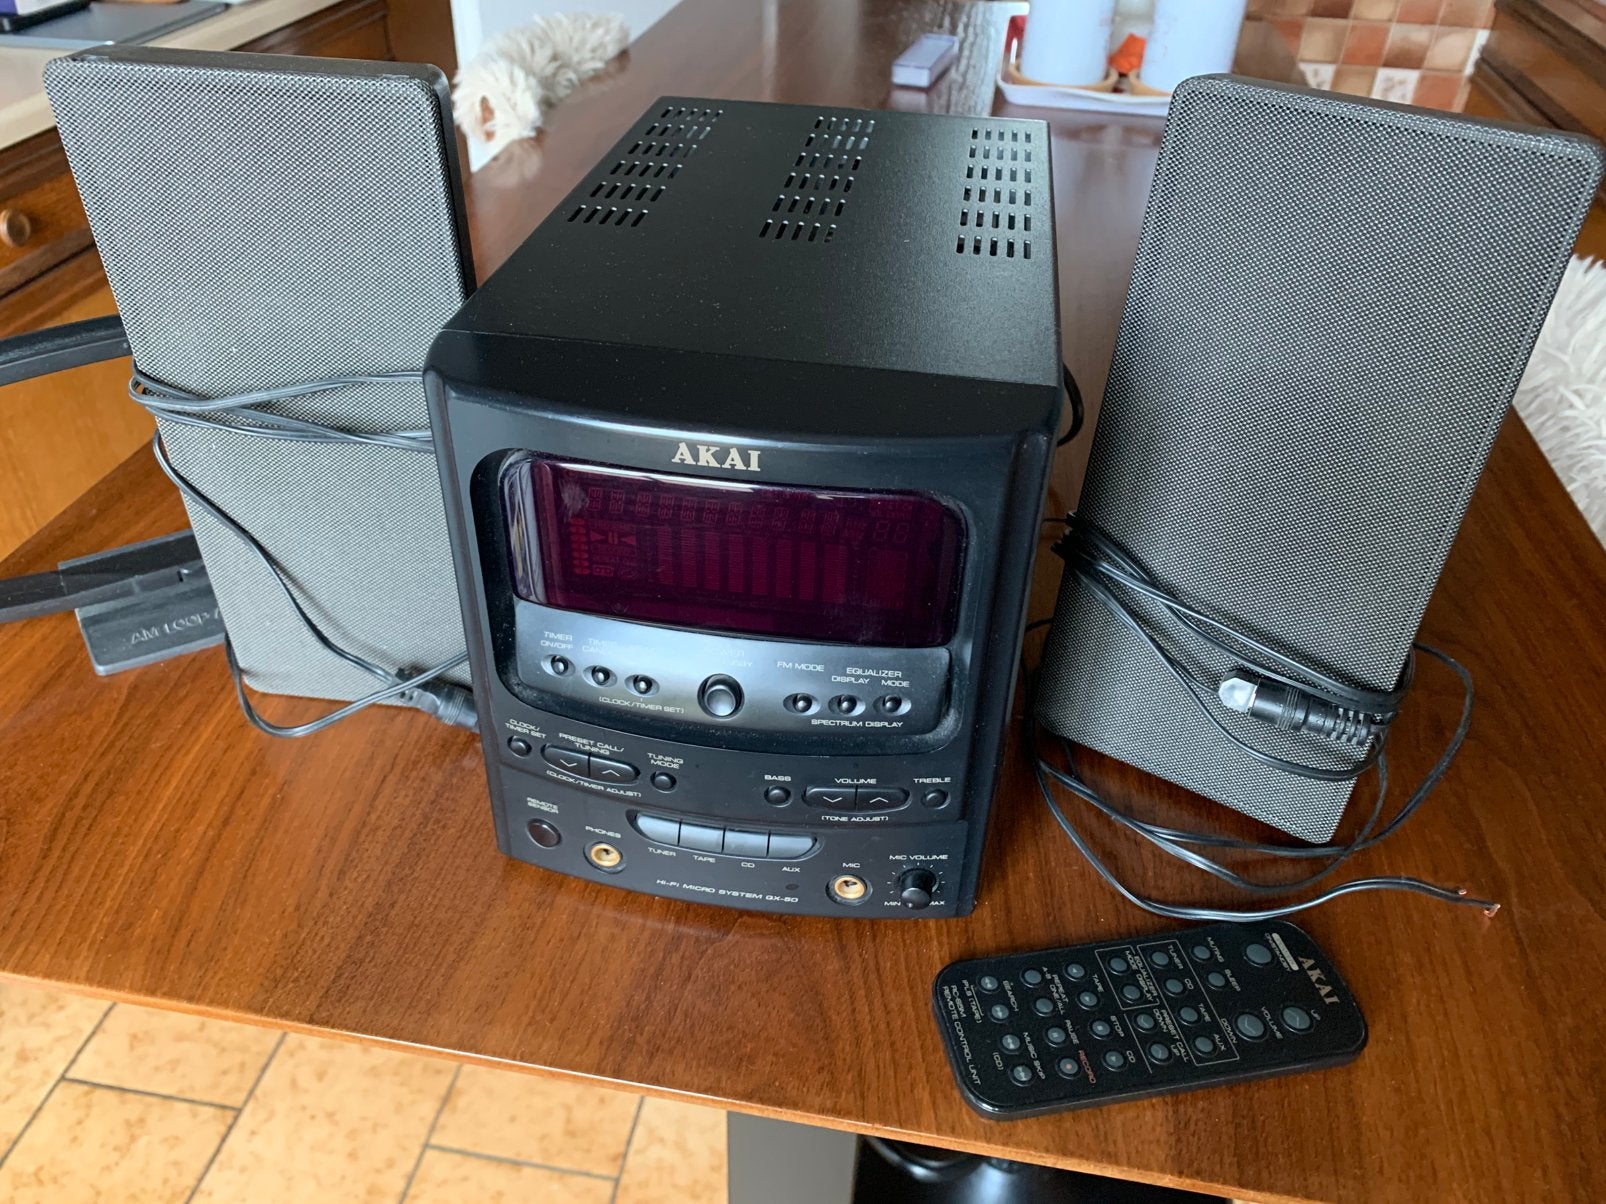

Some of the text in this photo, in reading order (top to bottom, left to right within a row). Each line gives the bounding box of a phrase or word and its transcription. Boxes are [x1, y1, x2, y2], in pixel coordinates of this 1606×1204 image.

[671, 442, 761, 472] AKAI
[131, 626, 159, 644] AM
[543, 631, 573, 641] TIMER
[540, 639, 574, 650] ON/OFF
[777, 661, 825, 672] FM MODE
[846, 667, 902, 678] EQUALIZER
[831, 675, 910, 688] DISPLAY MODE
[505, 722, 547, 739] TIMER SET
[509, 718, 540, 731] CLOCK/
[811, 718, 904, 728] SPECTRUM DISPLAY
[558, 732, 625, 752] PRESET CALL/
[574, 742, 610, 755] TUNING
[647, 752, 684, 764] TUNING
[650, 758, 680, 769] MODE
[764, 774, 792, 782] BASS
[834, 777, 877, 785] VOLUME
[585, 825, 621, 839] PHONES
[647, 846, 677, 858] TUNER
[693, 854, 716, 863] TAPE
[740, 861, 755, 869] CD
[682, 883, 716, 894] MICRO
[718, 889, 763, 900] SYSTEM
[1168, 945, 1184, 970] TUNER
[1206, 936, 1225, 963] MUTING
[1092, 973, 1104, 993] TAPE
[1125, 950, 1154, 1002] MODE DISPLAY
[1134, 955, 1159, 996] EQUALIZER
[1223, 968, 1241, 992] SLEEP
[1297, 956, 1340, 1005] AKAI
[1152, 1008, 1169, 1033] DOWN
[1198, 1002, 1212, 1022] TAPE
[1065, 1019, 1080, 1045] PAUSE
[1110, 1015, 1125, 1037] STOP
[1220, 1018, 1238, 1044] DOWN
[1261, 1006, 1283, 1040] VOLUME
[1161, 1009, 1189, 1062] PRESET CALL
[1213, 1033, 1227, 1051] AUX
[954, 1021, 973, 1063] CONTROL
[968, 1064, 982, 1085] UNIT
[1022, 1031, 1046, 1080] MUSIC SKIP
